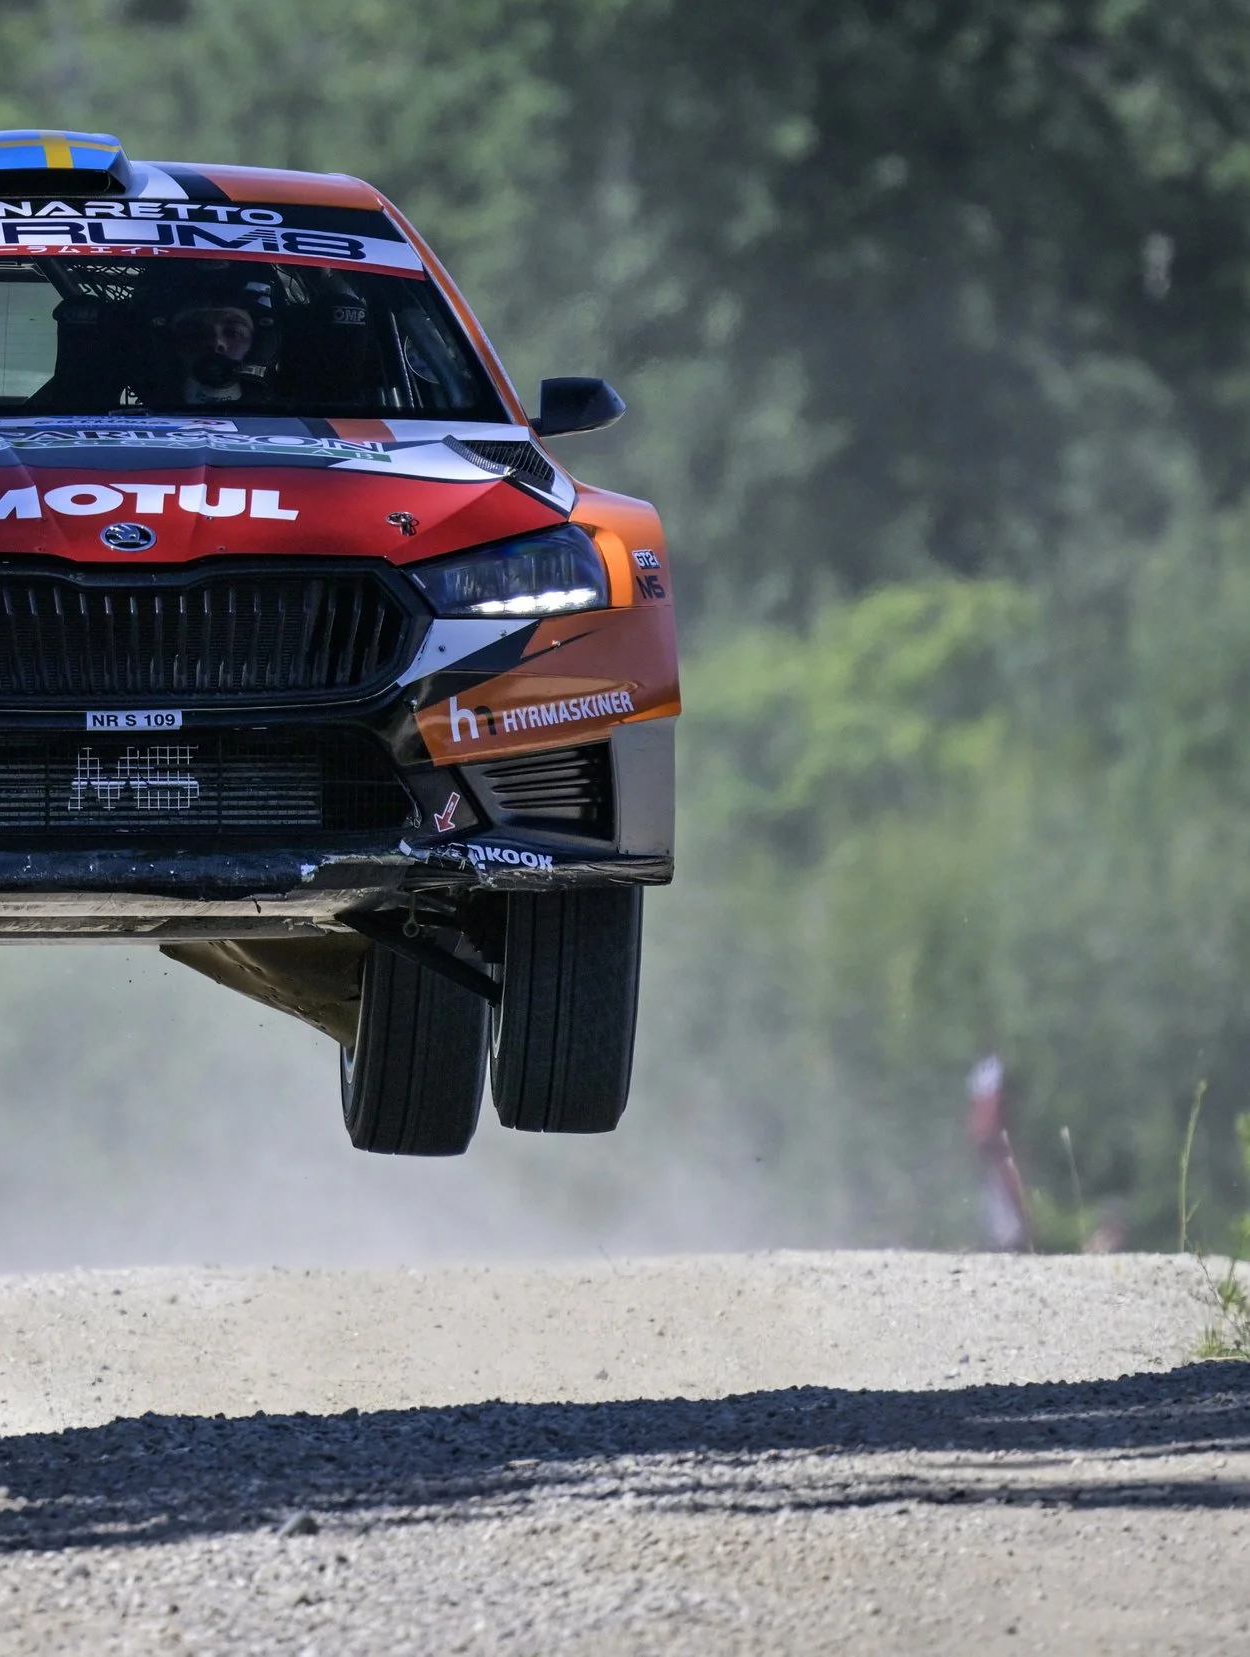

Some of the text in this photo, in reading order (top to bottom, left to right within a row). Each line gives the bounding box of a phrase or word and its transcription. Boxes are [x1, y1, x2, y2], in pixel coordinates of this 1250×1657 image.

[333, 310, 366, 321] OMP
[502, 691, 635, 733] HYRMASKINER
[92, 713, 176, 727] NR S 109
